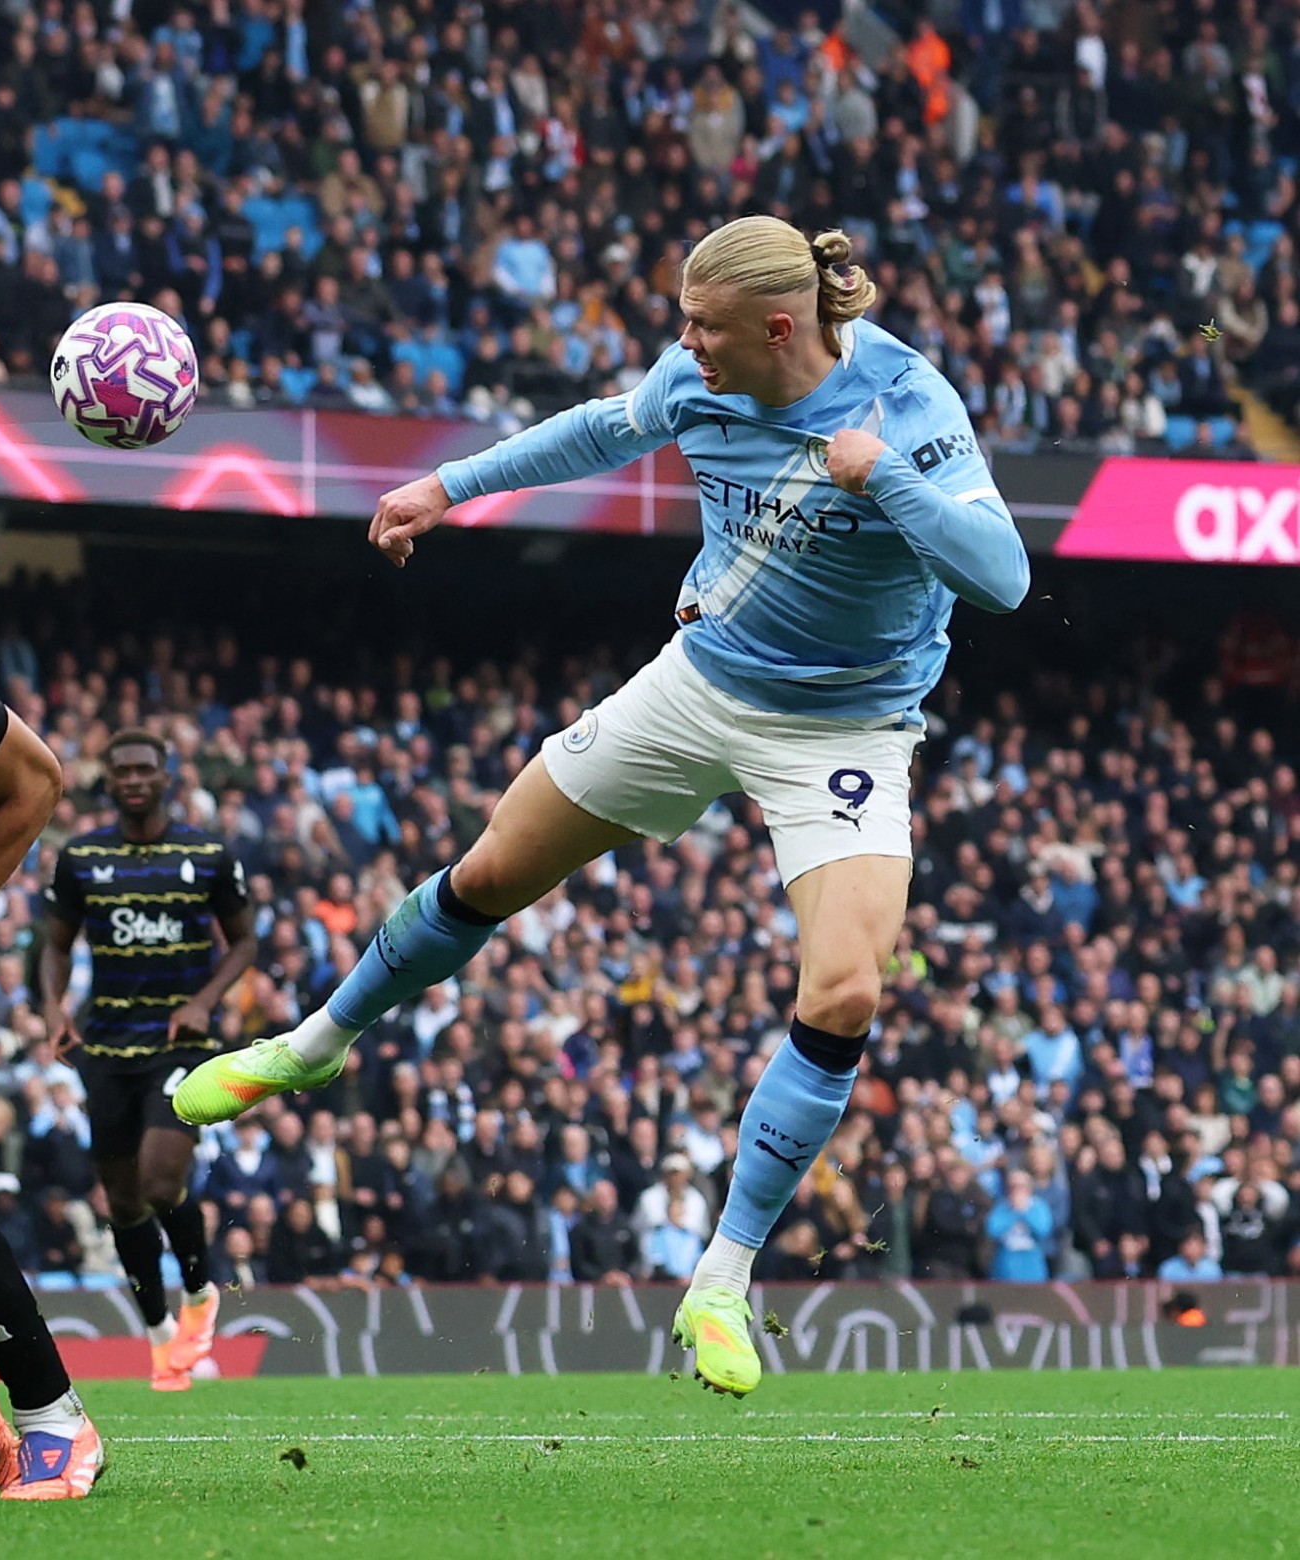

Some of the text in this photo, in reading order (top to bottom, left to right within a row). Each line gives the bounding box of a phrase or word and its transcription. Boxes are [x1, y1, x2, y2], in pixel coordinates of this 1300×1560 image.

[696, 470, 860, 534] ETIHAD
[1174, 483, 1300, 562] ax
[722, 519, 820, 555] AIRWAYS
[828, 768, 874, 810] 9
[110, 907, 183, 946] Stake
